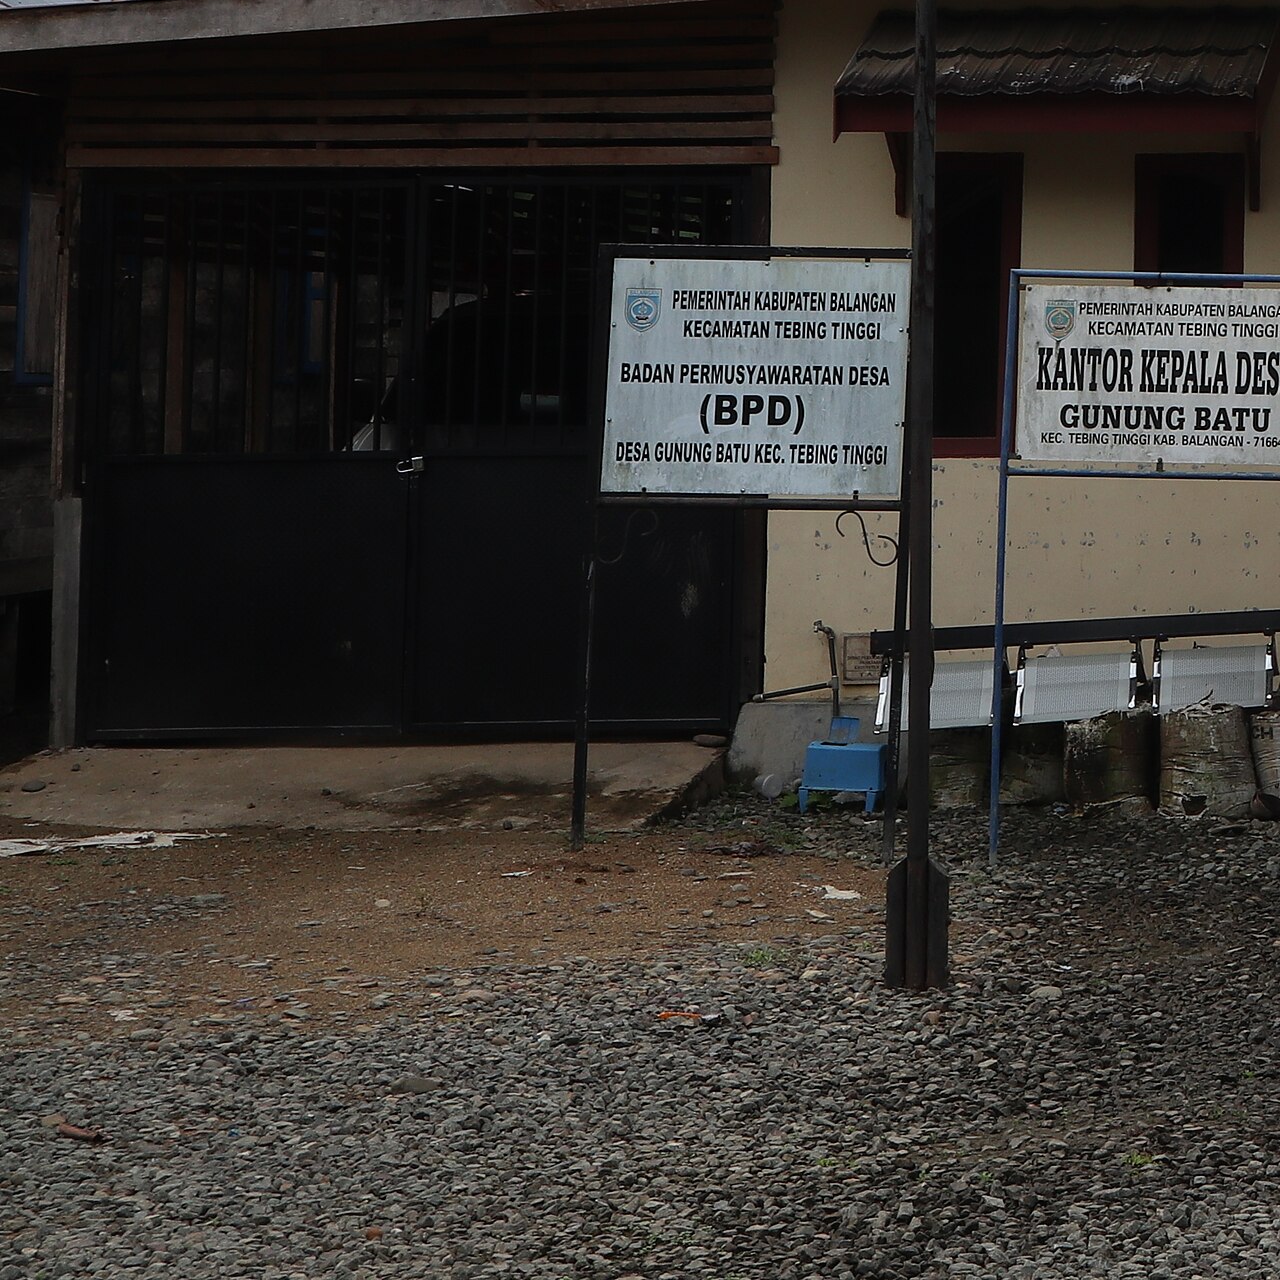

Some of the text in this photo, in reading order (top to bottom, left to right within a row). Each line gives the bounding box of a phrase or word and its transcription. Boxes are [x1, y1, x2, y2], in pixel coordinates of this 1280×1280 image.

[672, 290, 896, 312] PEMERINTAH KABUPATEN BALANGAN
[1079, 302, 1153, 316] PEMERINTAH
[1156, 304, 1225, 317] KABUPATEN
[683, 320, 881, 340] KECAMATAN TEBING TINGGI
[1088, 321, 1279, 338] KECAMATAN TEBING TINGGI
[620, 363, 890, 386] BADAN PERMUSYAWARATAN DESA
[1036, 347, 1133, 392] KANTOR
[1139, 349, 1229, 394] KEPALA
[700, 394, 805, 434] (BPD)
[1060, 404, 1271, 432] GUNUNG BATU
[1041, 433, 1065, 444] KEC.
[1069, 433, 1109, 444] TEBING
[1112, 434, 1151, 445] TINGGI
[1153, 434, 1179, 446] KAB.
[1181, 435, 1244, 447] BALANGAN
[616, 442, 887, 465] DESA GUNUNG BATU KEC. TEBING TINGGI
